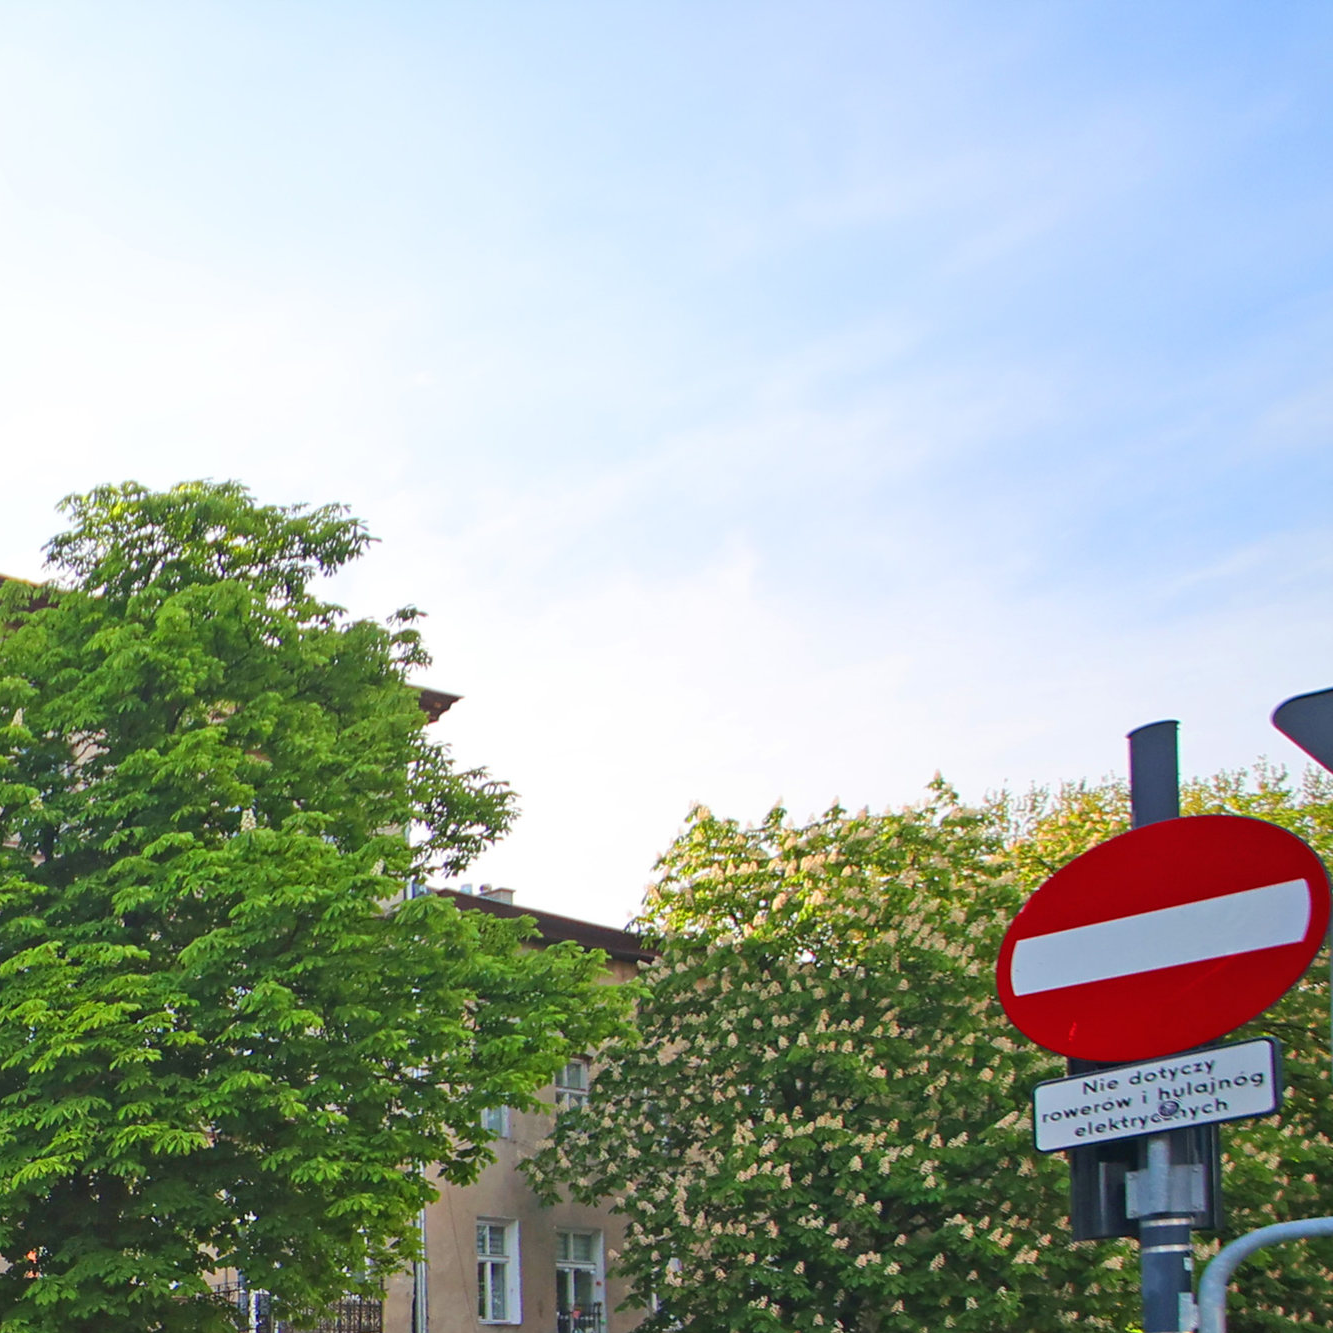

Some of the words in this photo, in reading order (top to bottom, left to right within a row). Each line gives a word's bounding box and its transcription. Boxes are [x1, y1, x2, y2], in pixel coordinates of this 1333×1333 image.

[1041, 1097, 1132, 1123] rowerów
[1141, 1090, 1148, 1104] i
[1158, 1070, 1265, 1101] hulajnóg
[1082, 1078, 1119, 1095] Nie
[1128, 1059, 1216, 1086] dotyczy
[1074, 1098, 1229, 1138] elektrycnych
